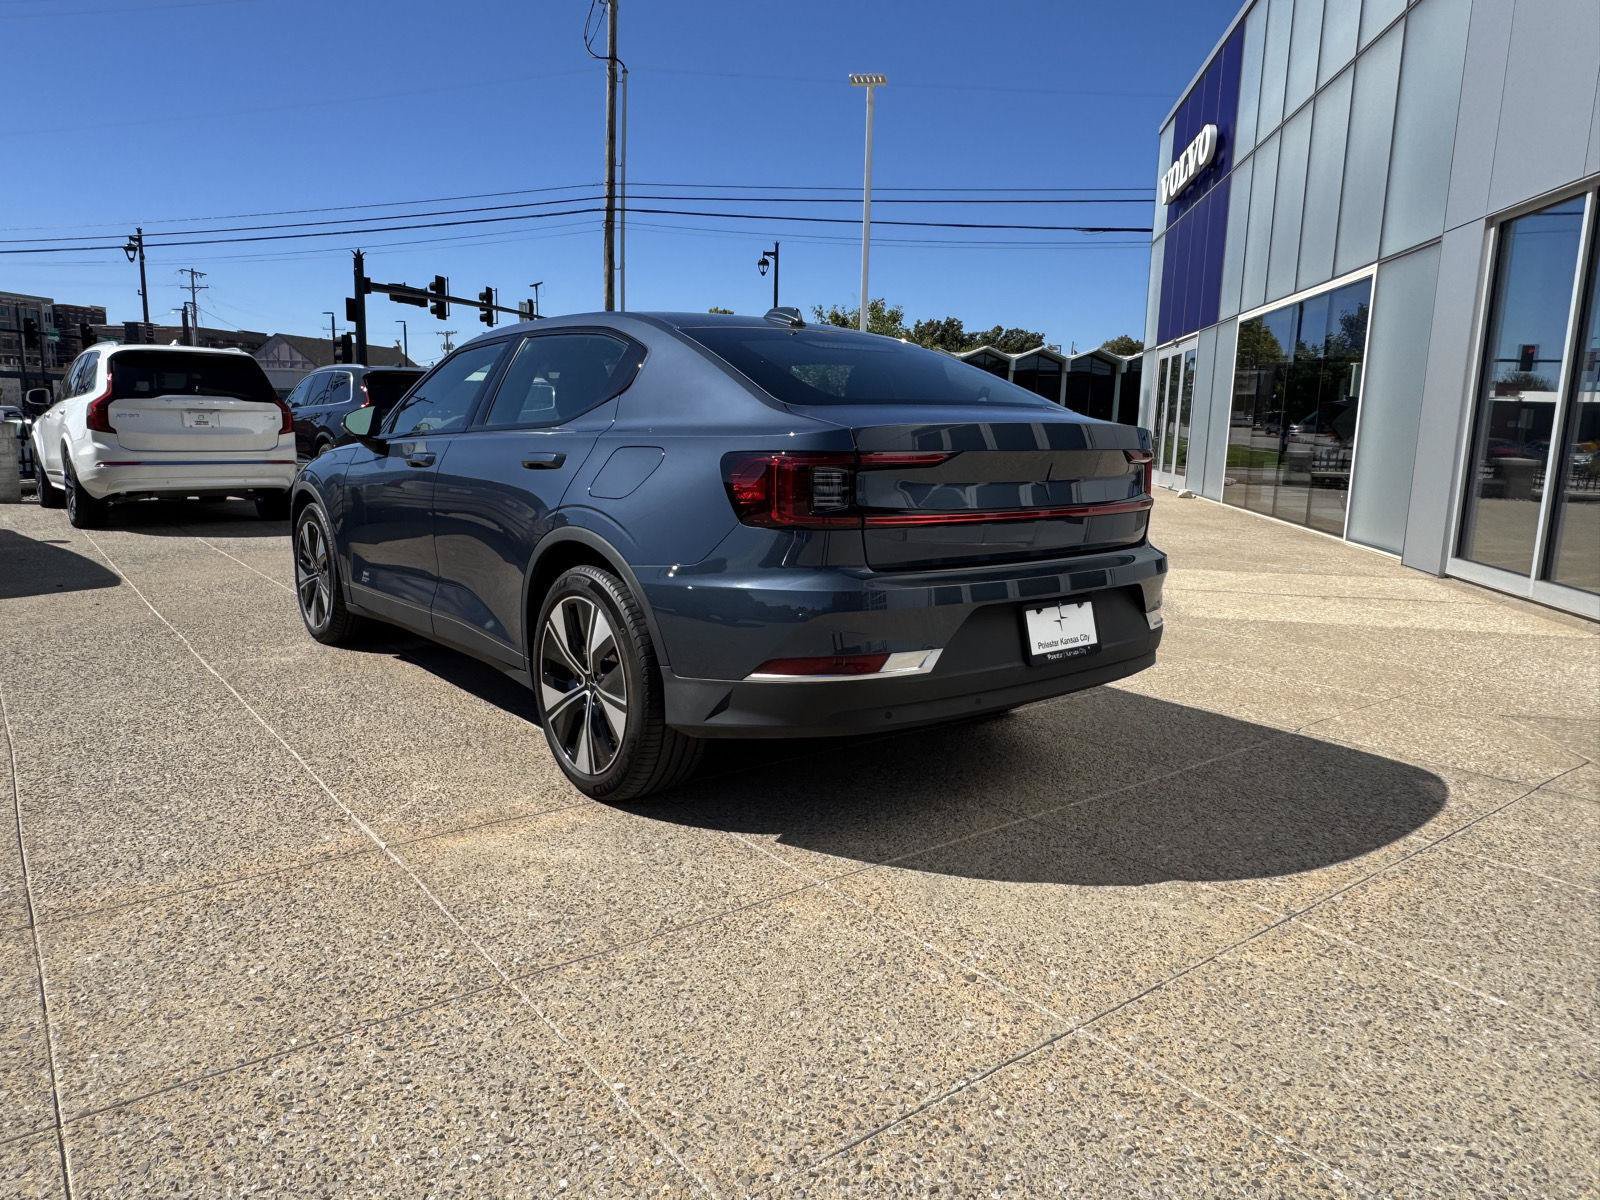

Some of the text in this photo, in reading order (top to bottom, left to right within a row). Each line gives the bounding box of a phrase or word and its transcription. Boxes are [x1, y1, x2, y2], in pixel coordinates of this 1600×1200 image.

[1160, 124, 1215, 205] VOLVO
[1038, 633, 1090, 650] Polestar Kansas City
